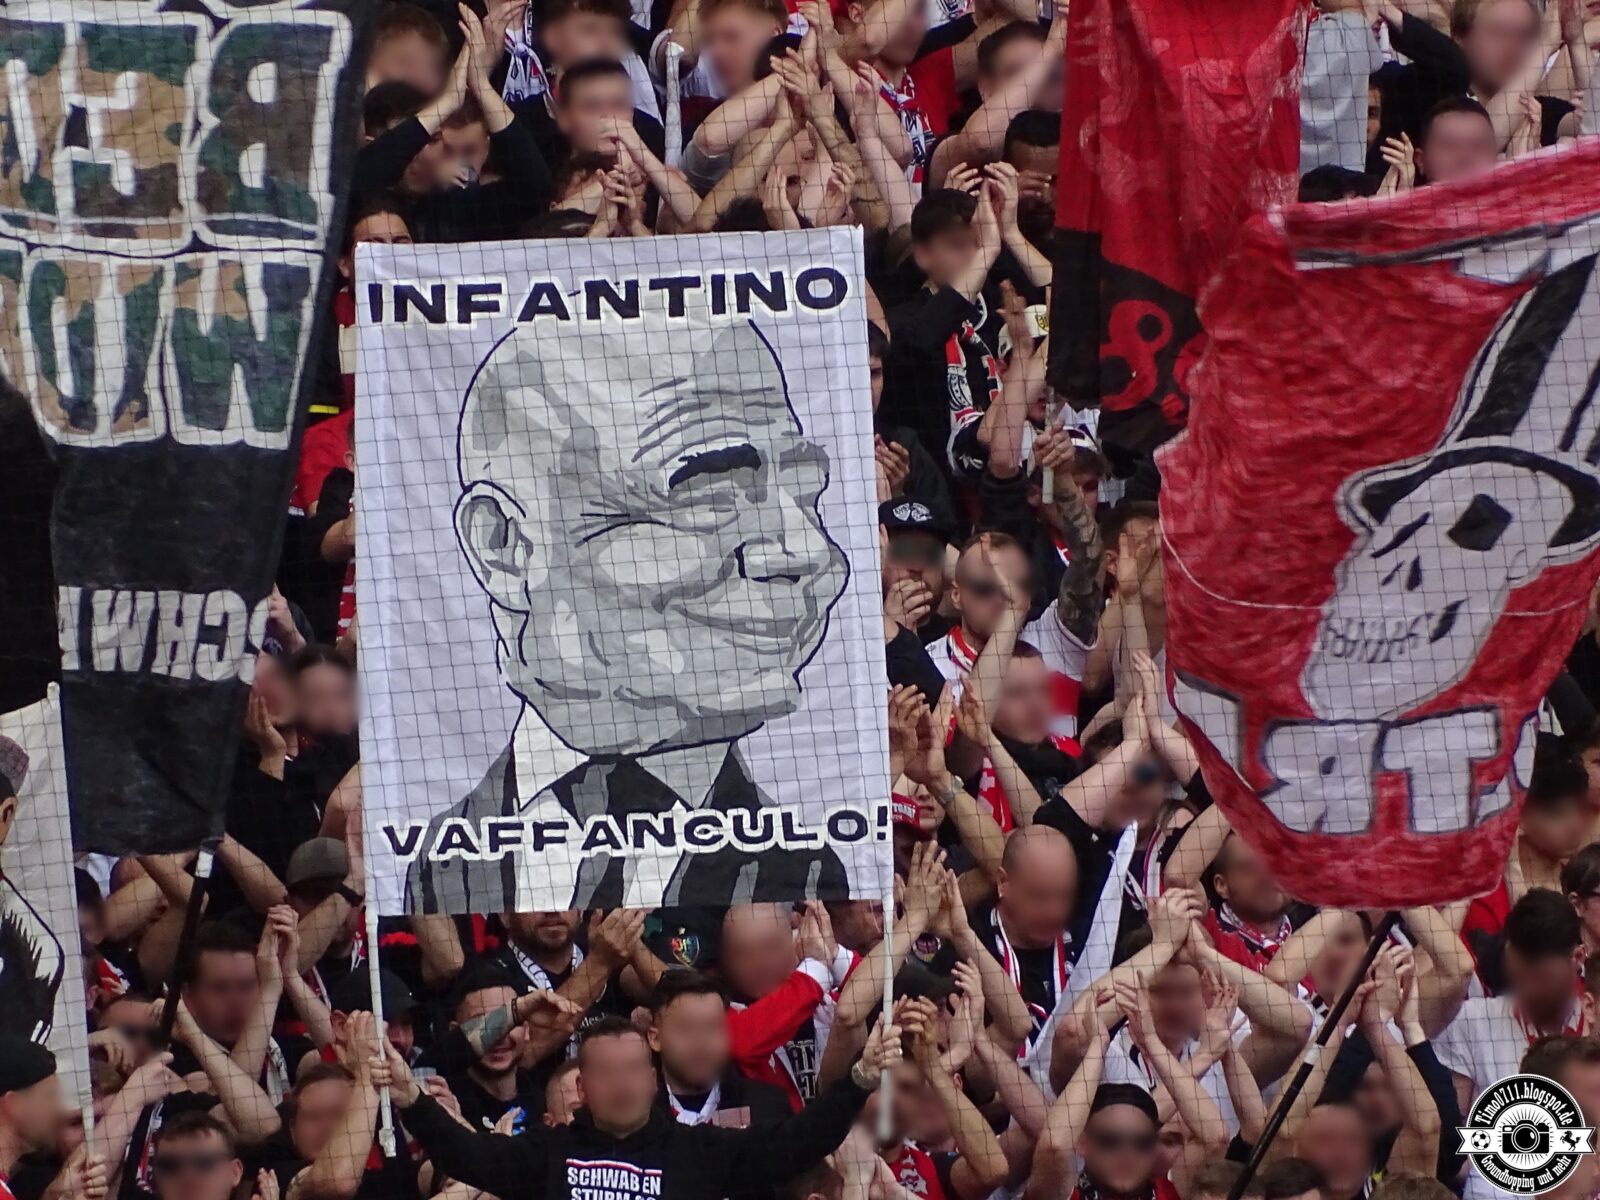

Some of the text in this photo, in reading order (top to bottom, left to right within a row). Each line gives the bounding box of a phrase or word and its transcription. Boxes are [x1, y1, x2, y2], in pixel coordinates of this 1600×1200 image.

[368, 267, 848, 324] INFANTINO
[382, 805, 889, 856] VAFFANCULO!
[567, 1166, 661, 1196] SCHWABEN
